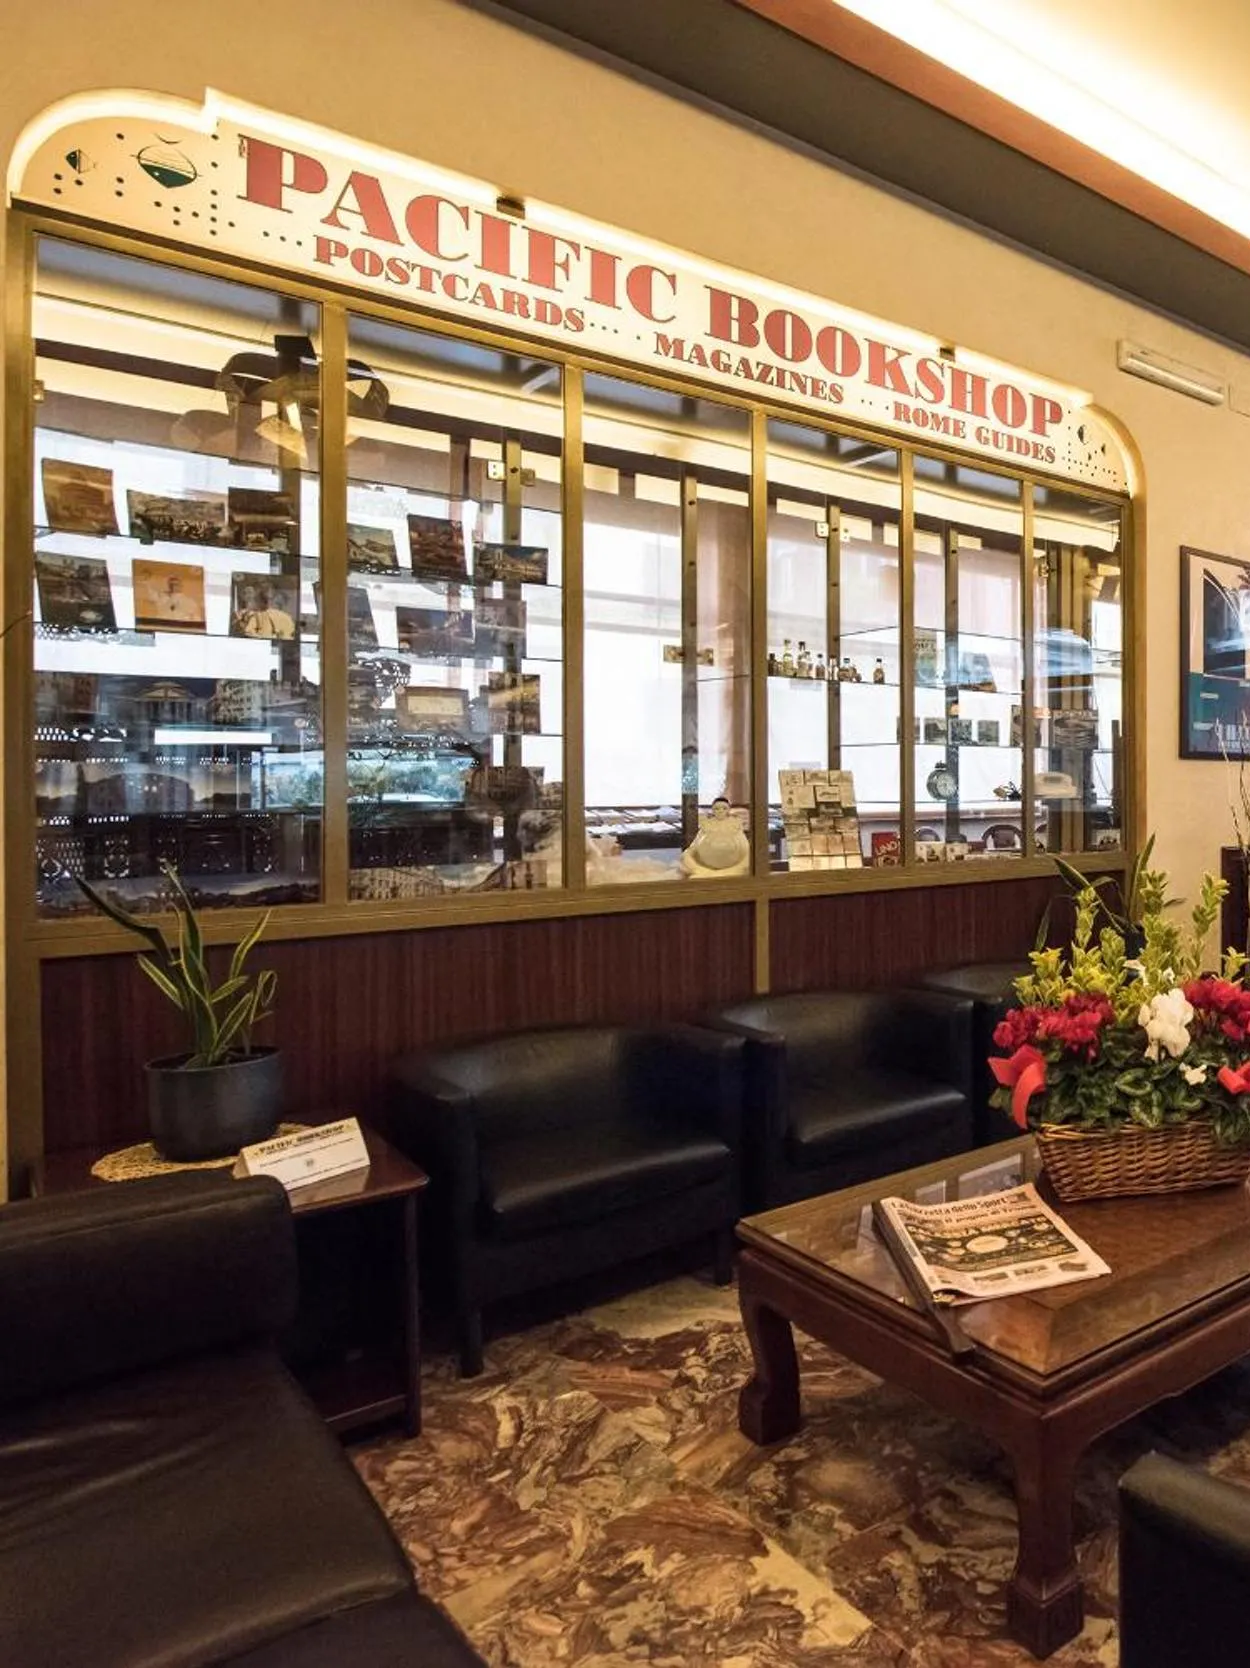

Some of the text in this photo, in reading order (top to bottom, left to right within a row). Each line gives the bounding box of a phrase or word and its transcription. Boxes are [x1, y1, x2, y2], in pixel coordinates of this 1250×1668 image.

[236, 133, 1064, 439] PACIFIC BOOKSHOP
[313, 234, 586, 333] POSTCARDS
[653, 331, 844, 404] MAGAZINES
[892, 401, 1056, 464] ROME GUIDES
